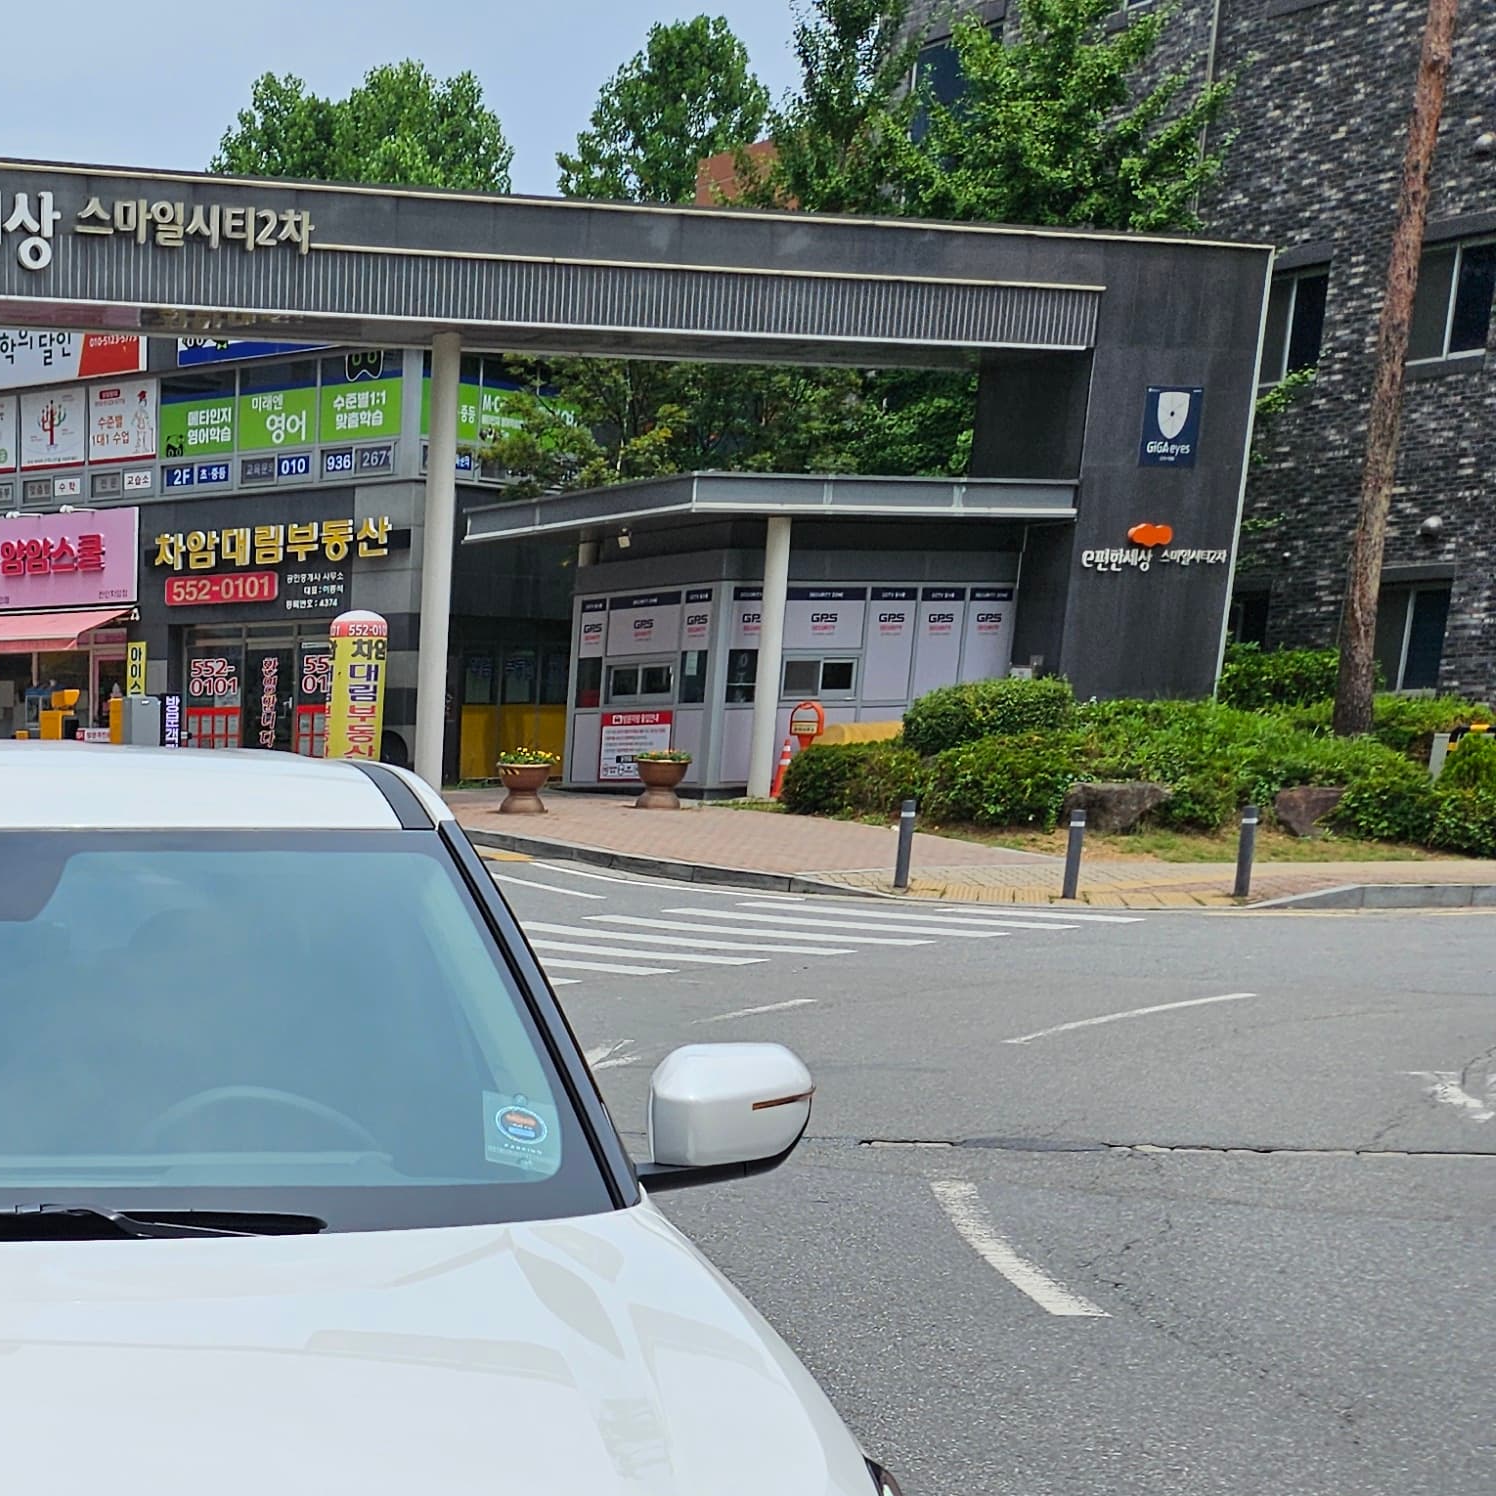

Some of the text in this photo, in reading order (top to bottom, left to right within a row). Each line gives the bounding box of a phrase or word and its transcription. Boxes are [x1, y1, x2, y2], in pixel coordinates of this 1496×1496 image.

[74, 196, 315, 255] 스마일시티2차
[38, 332, 71, 366] 달인
[266, 410, 306, 444] 영어
[1170, 444, 1191, 456] eyes
[281, 458, 306, 474] 010
[173, 469, 191, 485] 2F
[155, 516, 392, 570] 차암대림부동산
[0, 533, 106, 577] 얌얌스쿨
[1082, 548, 1153, 572] e편한세상
[172, 576, 269, 600] 552-0101
[742, 613, 761, 623] GP
[811, 613, 838, 623] GPS
[879, 613, 904, 623] GPS
[928, 613, 954, 623] GPS
[976, 613, 1002, 623] GPS
[191, 658, 236, 677] 552-
[303, 654, 329, 674] 55
[190, 677, 238, 696] 0101
[302, 674, 328, 694] 01
